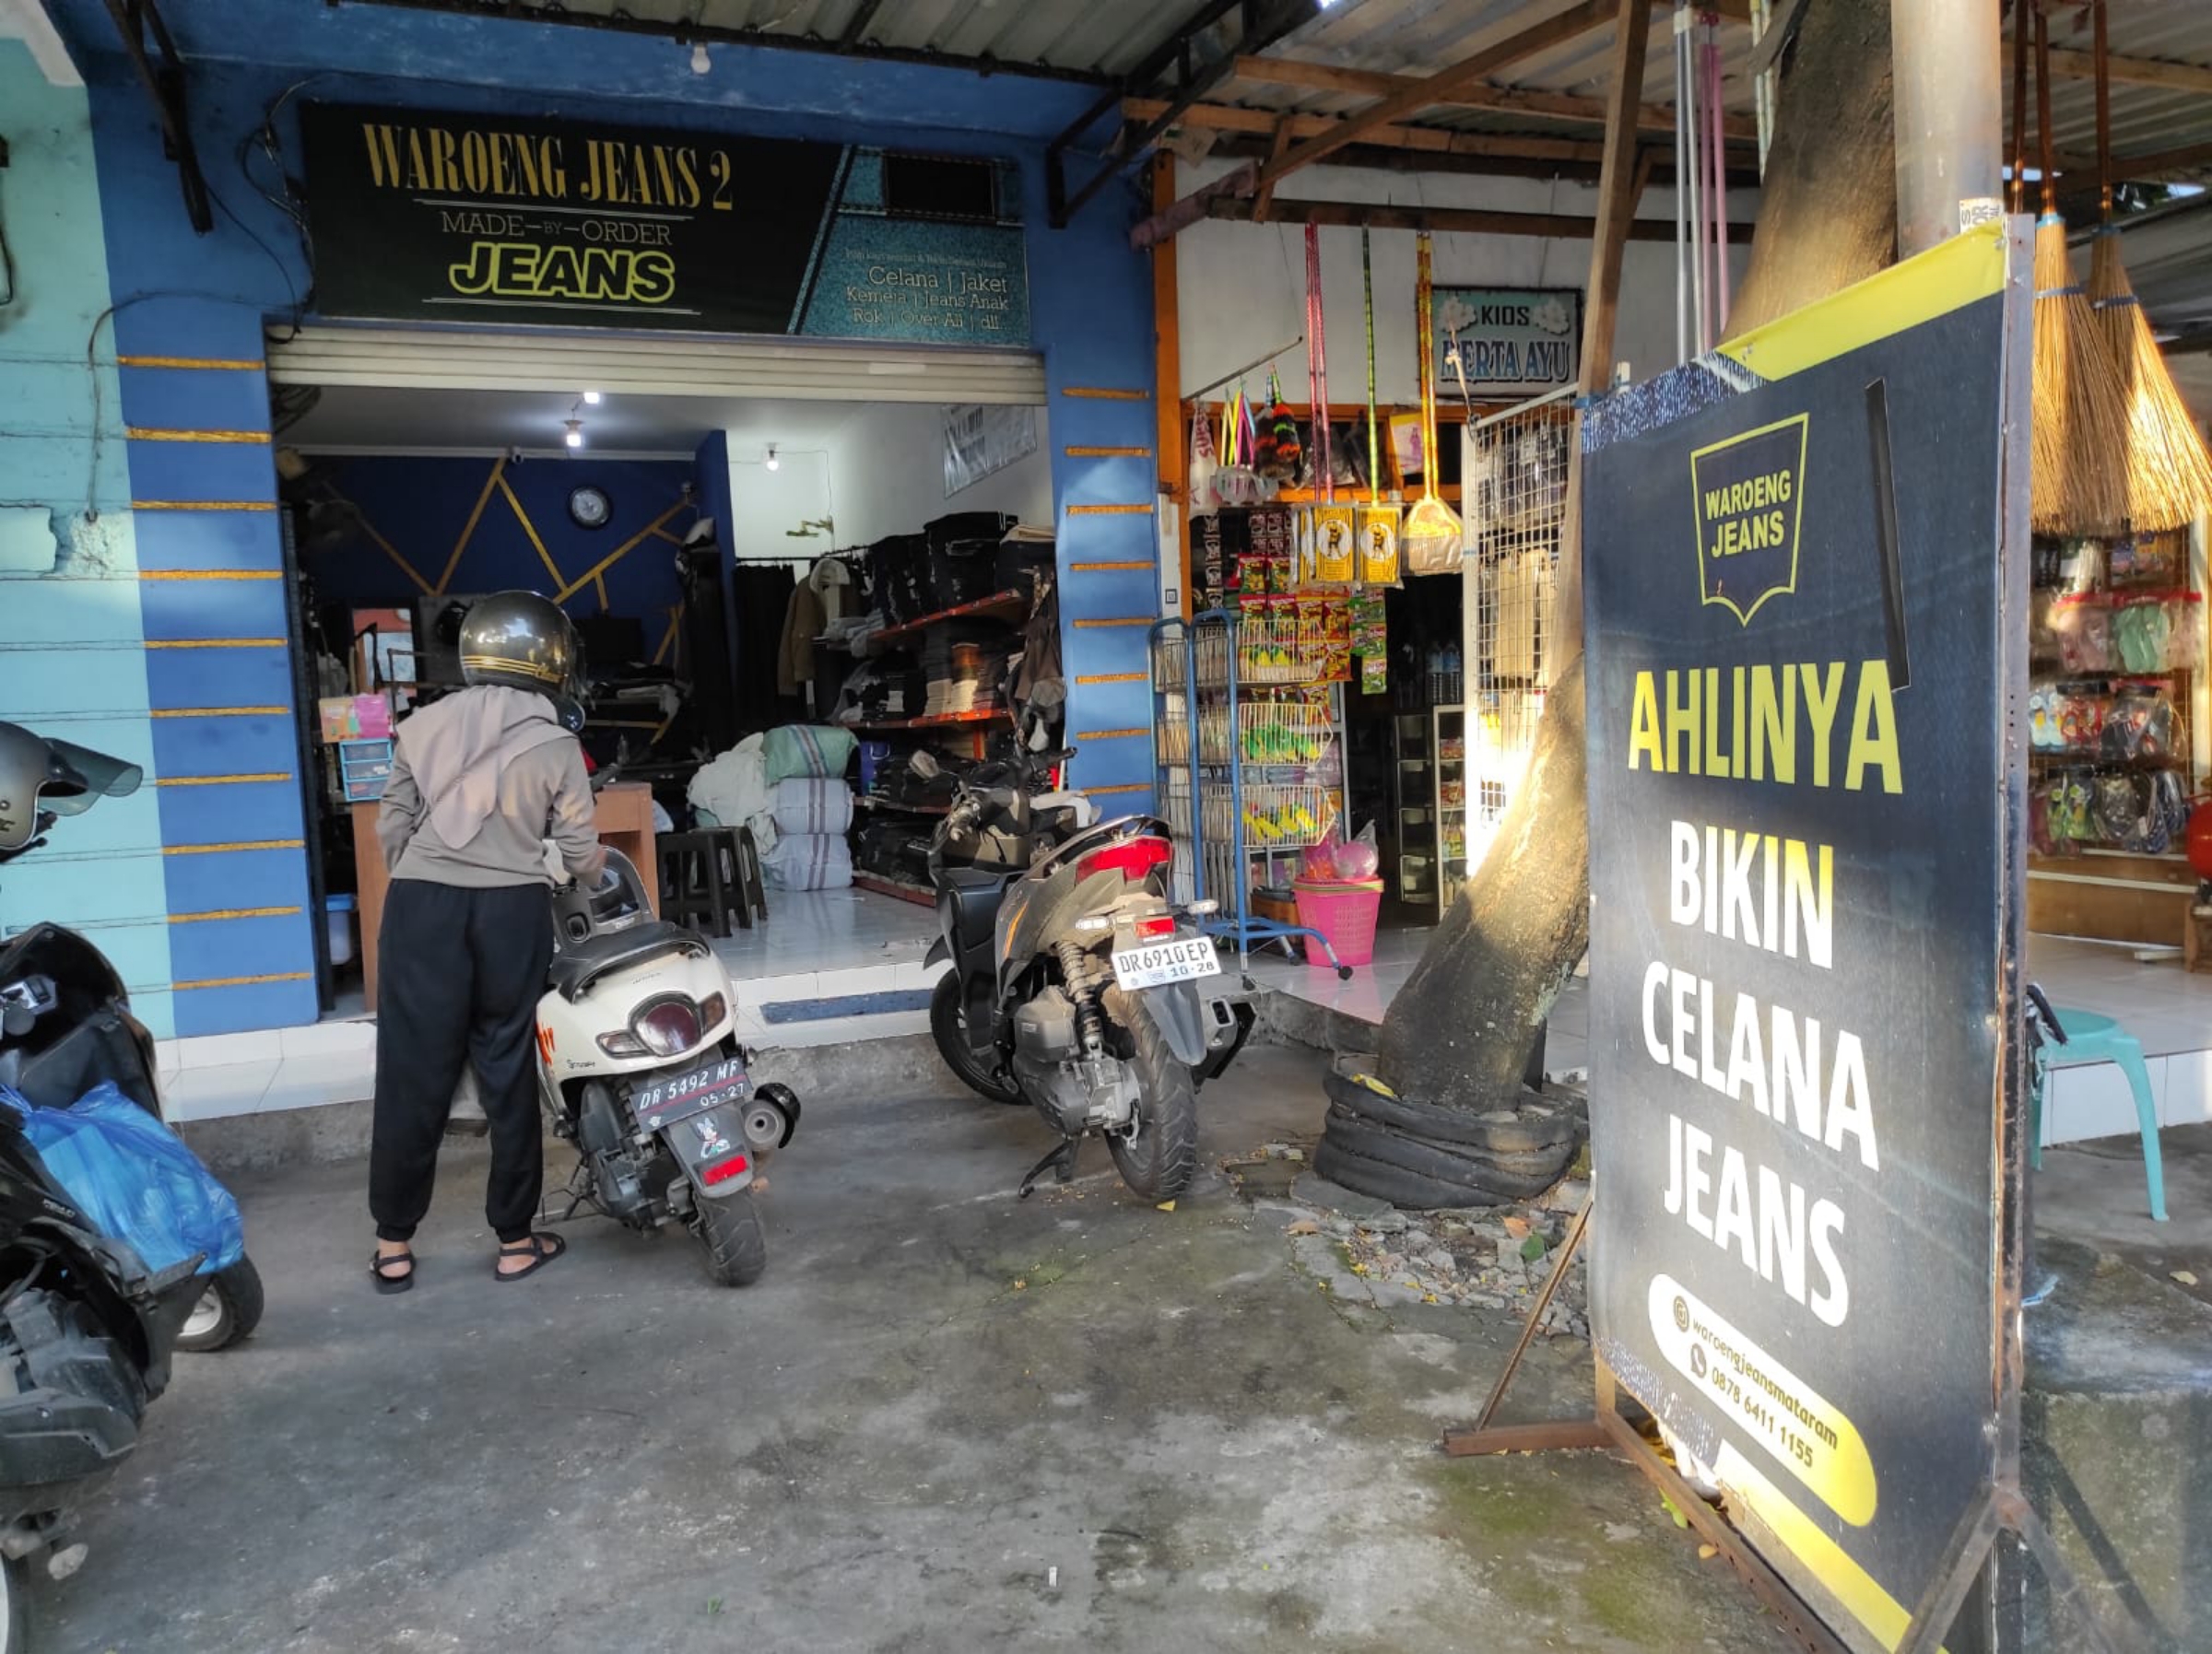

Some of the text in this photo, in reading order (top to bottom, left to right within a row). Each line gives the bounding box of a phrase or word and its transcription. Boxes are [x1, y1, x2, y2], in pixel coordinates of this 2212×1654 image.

[362, 123, 734, 211] WAROENG JEANS 2
[449, 241, 676, 303] JEANS
[868, 265, 1008, 296] Celana Jaket
[853, 307, 884, 323] Rok
[924, 290, 966, 310] Jeans
[970, 294, 1009, 311] Anak
[1481, 305, 1530, 326] KIOS
[1524, 340, 1569, 379] AYU
[1705, 469, 1792, 521] WAROENG
[1711, 510, 1784, 558] JEANS
[1628, 659, 1903, 794] AHLINYA
[1670, 820, 1834, 969] BIKIN
[1118, 942, 1208, 974] DR 6910 EP
[639, 1061, 737, 1109] DR 5492 MF
[1641, 961, 1879, 1172] CELANA
[1663, 1113, 1849, 1327] JEANS
[1692, 1318, 1839, 1450] waroengjeansmataram
[1712, 1367, 1814, 1468] 0878 6411 1155
